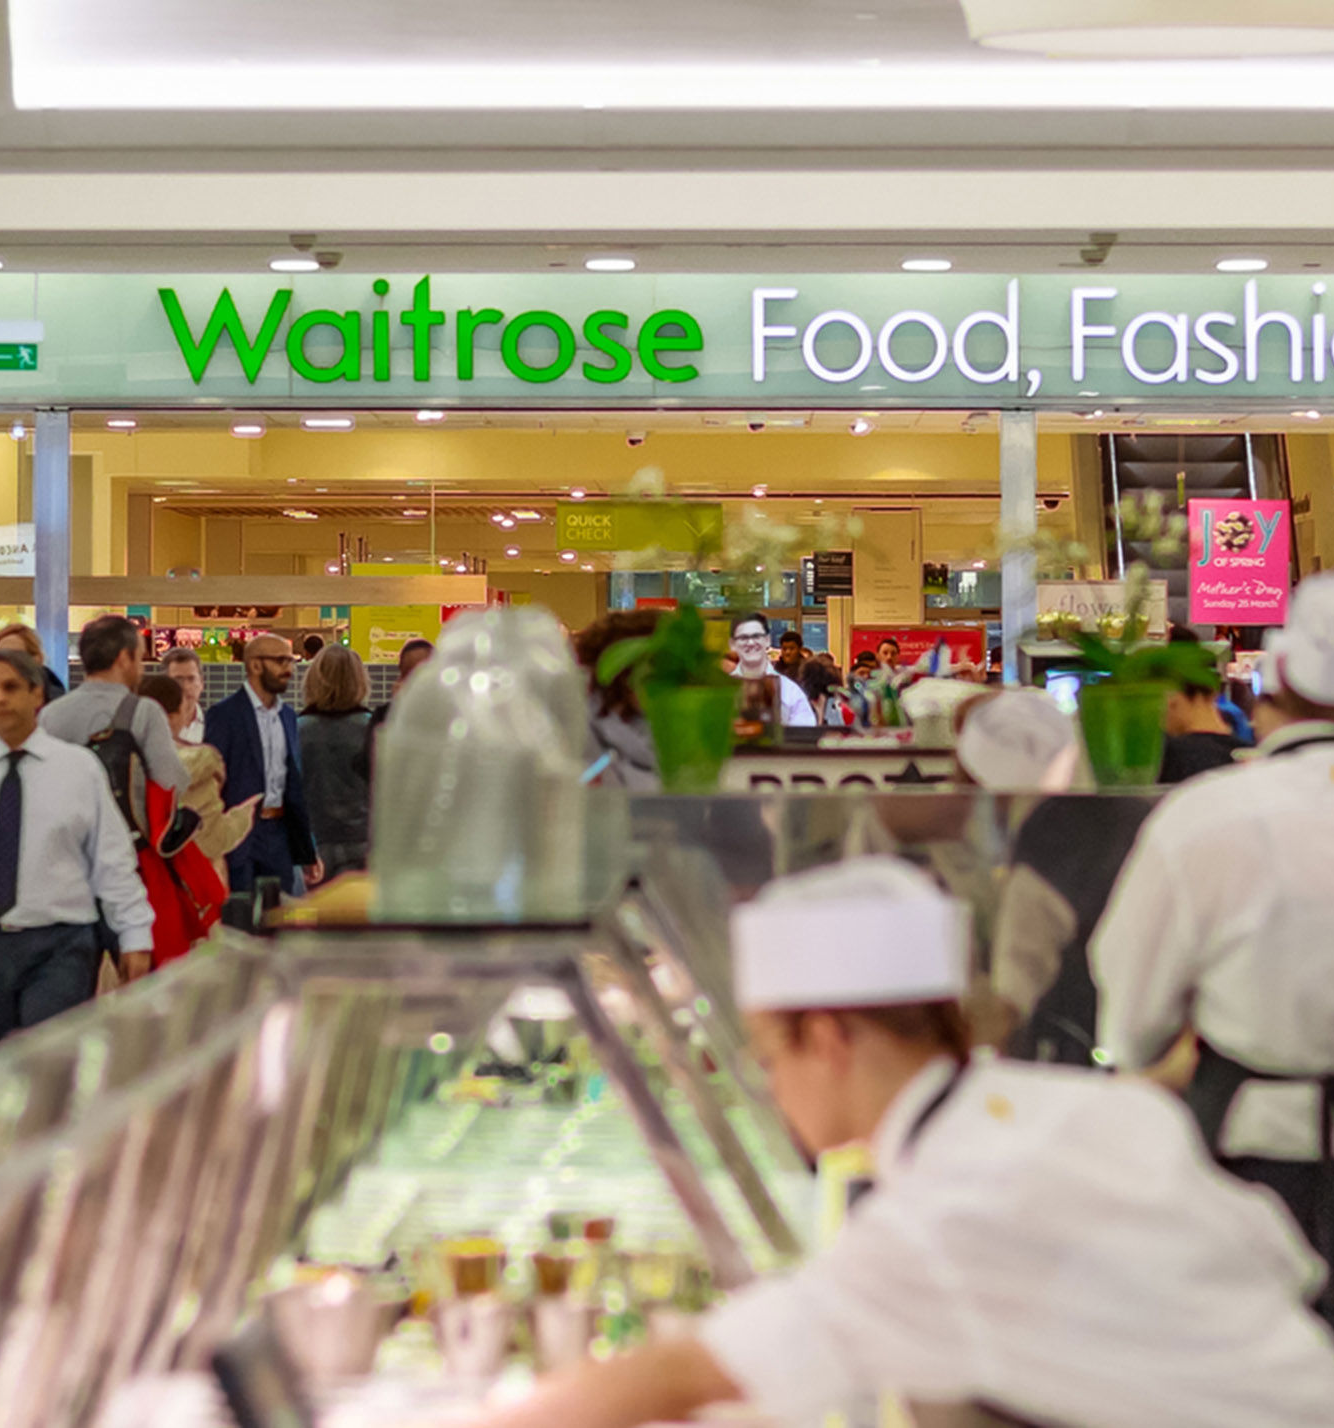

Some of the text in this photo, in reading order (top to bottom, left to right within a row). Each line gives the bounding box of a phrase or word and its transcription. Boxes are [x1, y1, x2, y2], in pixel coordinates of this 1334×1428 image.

[157, 274, 704, 385] Waitrose
[751, 278, 1042, 398] Food,
[567, 514, 611, 527] QUICK
[567, 528, 611, 541] CHECK
[1197, 509, 1283, 567] JOY
[1213, 557, 1266, 568] OF SPRING
[1197, 579, 1283, 601] Mother's Day
[1203, 599, 1236, 611] Sunday
[1250, 599, 1279, 609] March
